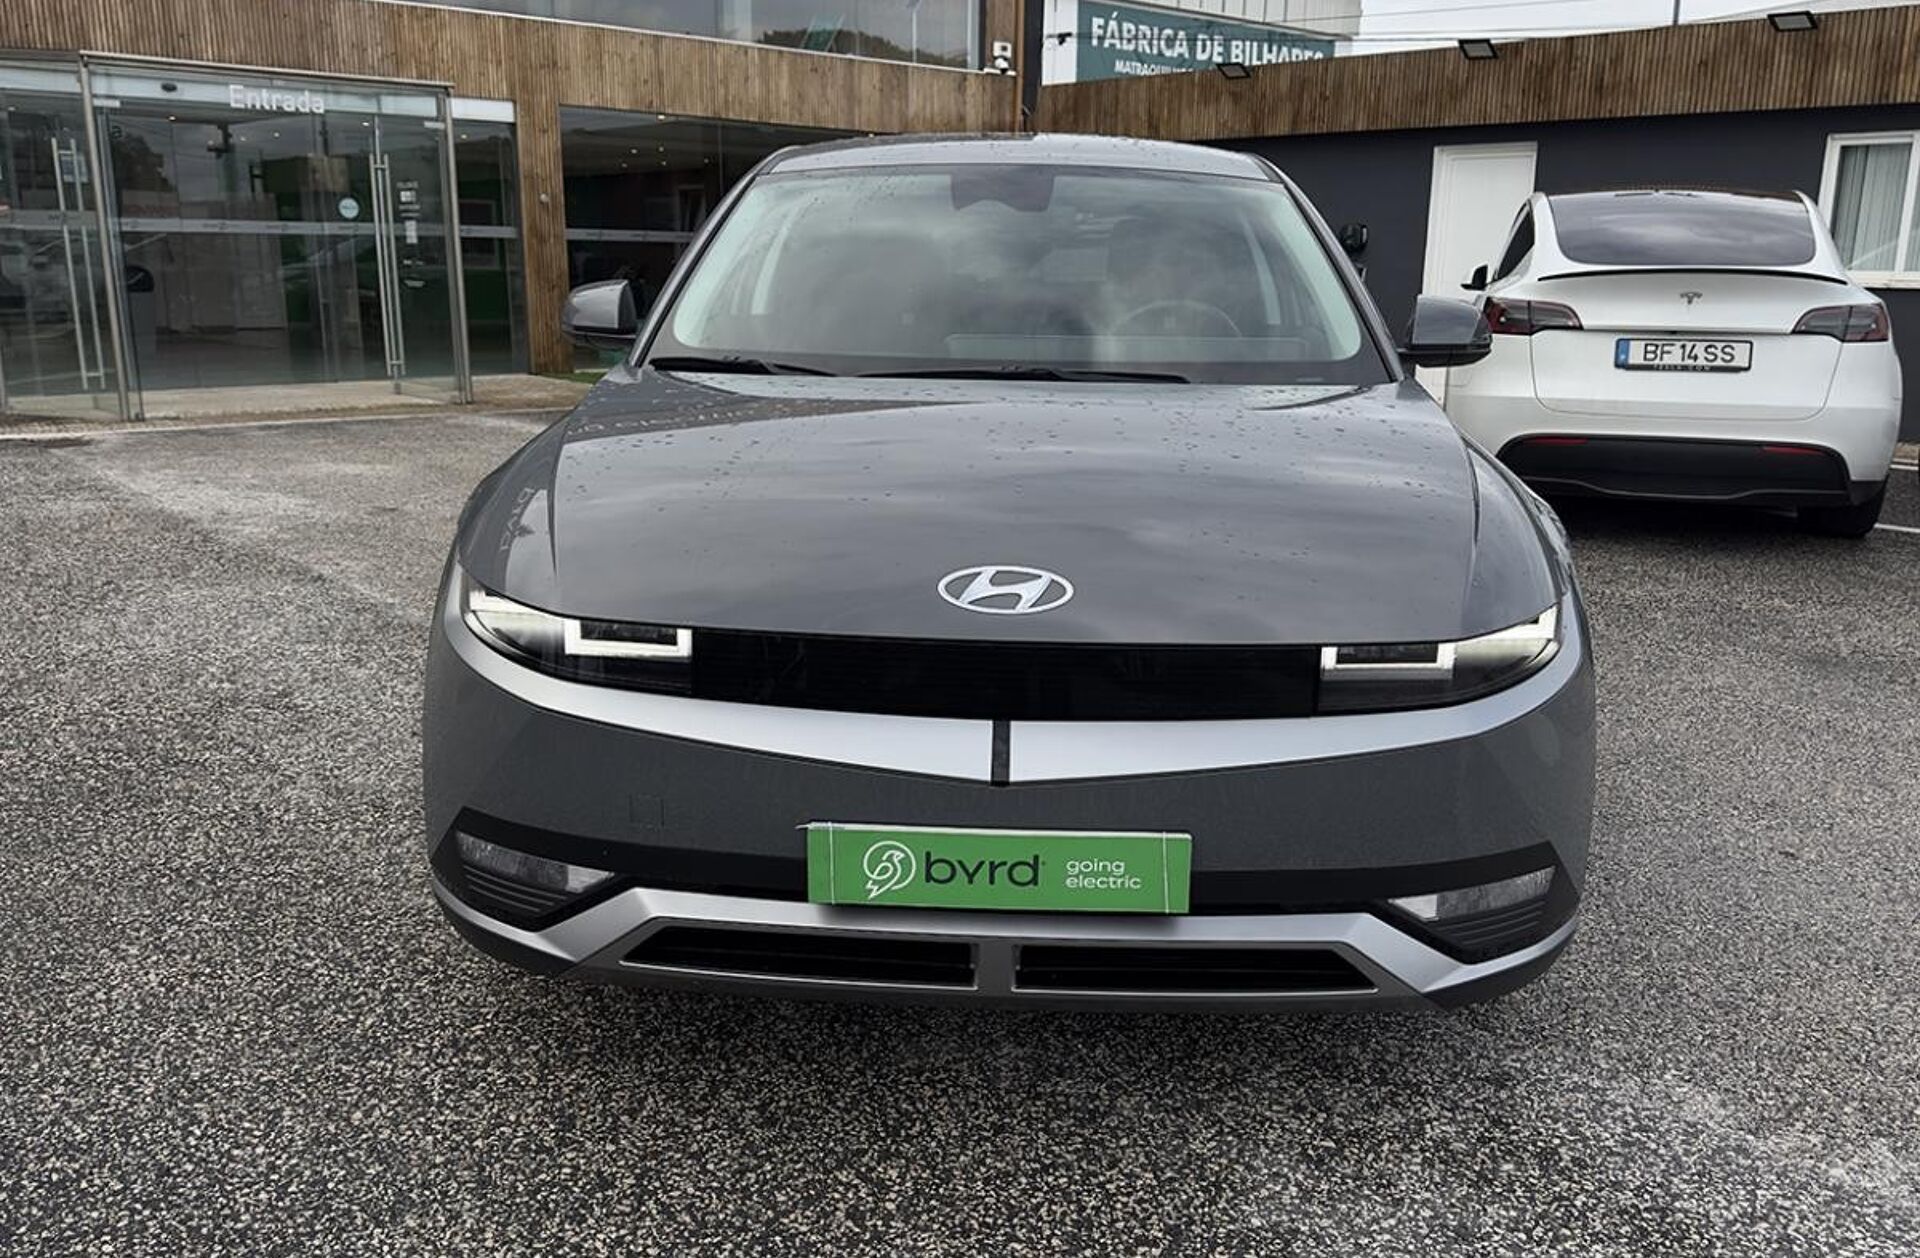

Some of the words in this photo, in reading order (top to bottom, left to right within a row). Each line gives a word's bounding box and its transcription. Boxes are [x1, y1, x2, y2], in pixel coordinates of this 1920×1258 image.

[1091, 11, 1189, 58] FÁBRICA
[1196, 35, 1223, 63] DE
[229, 84, 325, 113] Entrada
[1643, 343, 1675, 362] BF
[1680, 343, 1698, 362] 14
[1704, 344, 1735, 363] SS
[924, 851, 1040, 887] byrd
[1066, 858, 1126, 875] going
[1065, 874, 1142, 890] electric
